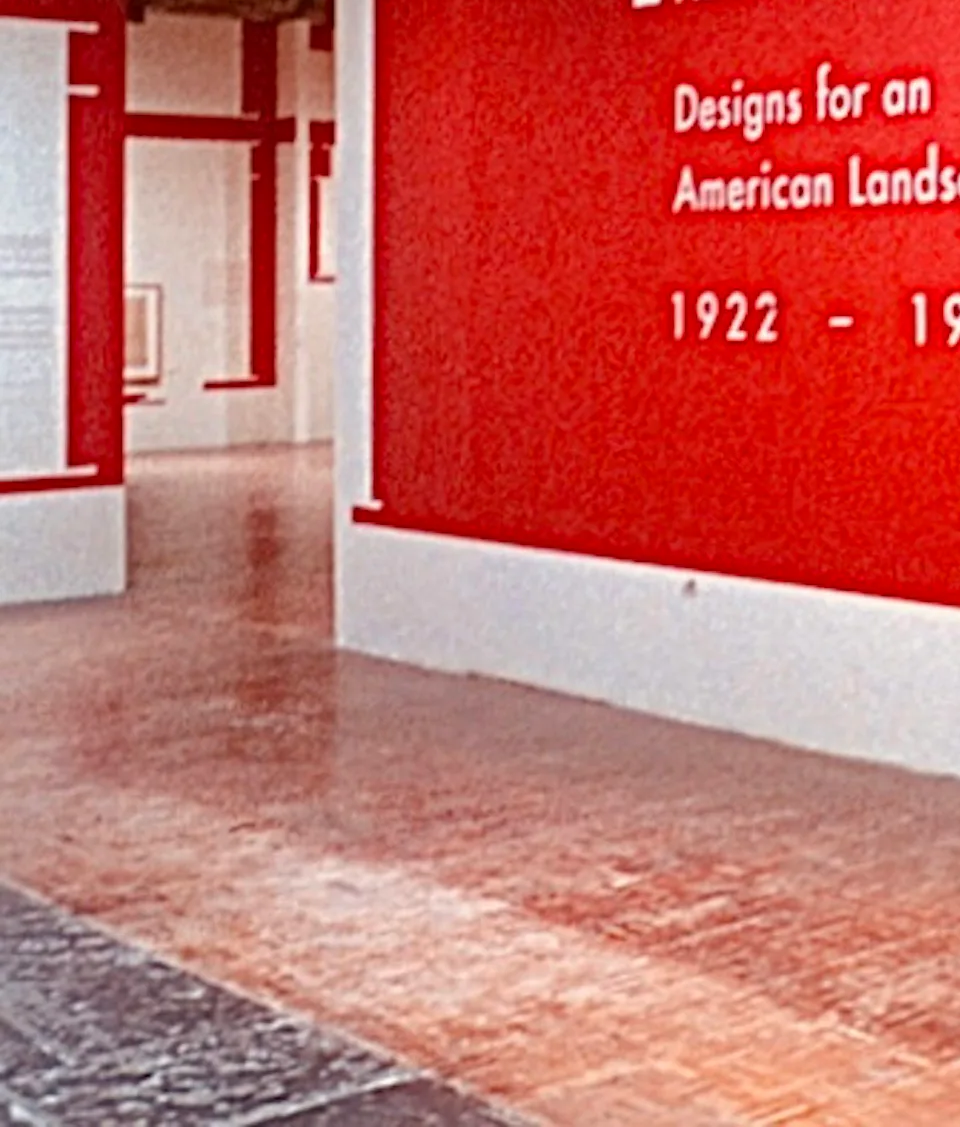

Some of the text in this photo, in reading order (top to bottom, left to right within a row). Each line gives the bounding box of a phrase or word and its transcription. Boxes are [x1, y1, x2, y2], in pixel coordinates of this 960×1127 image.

[674, 62, 931, 142] Designs for an
[672, 161, 834, 212] American
[671, 291, 779, 342] 1922
